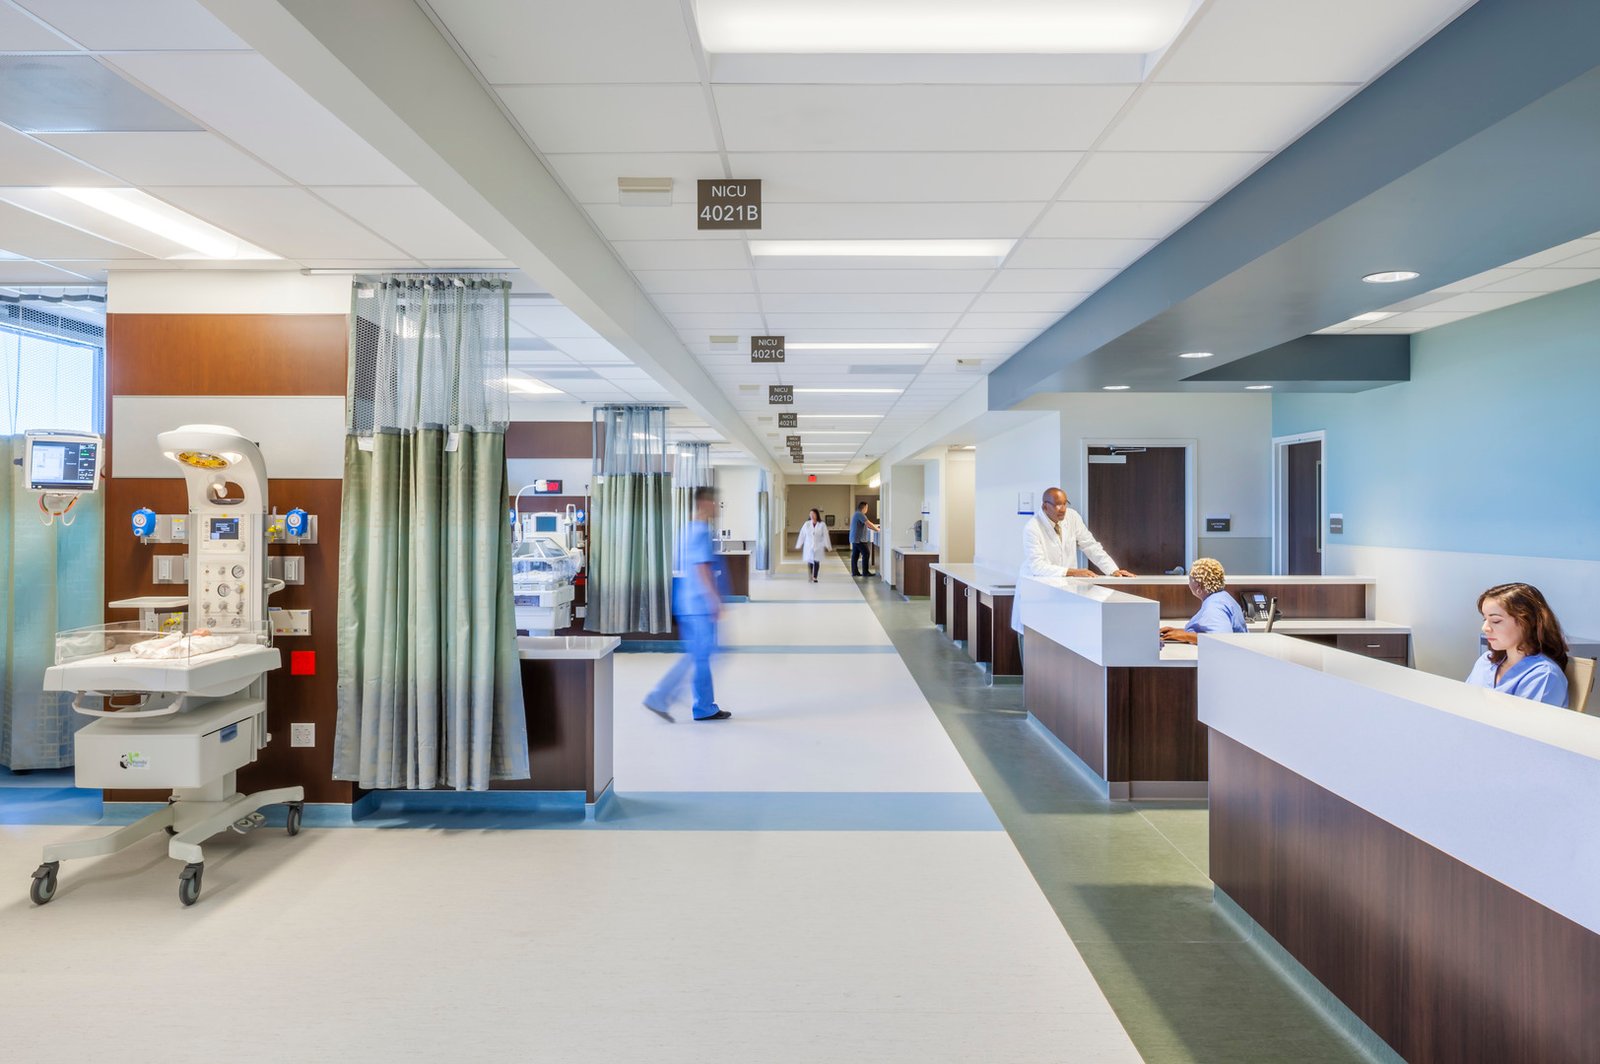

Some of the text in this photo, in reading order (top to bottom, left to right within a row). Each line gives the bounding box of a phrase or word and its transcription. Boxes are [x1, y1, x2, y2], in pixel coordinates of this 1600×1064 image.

[711, 185, 747, 197] NICU
[700, 205, 759, 221] 4021B
[752, 349, 784, 359] 4021C
[769, 394, 793, 402] 4021D
